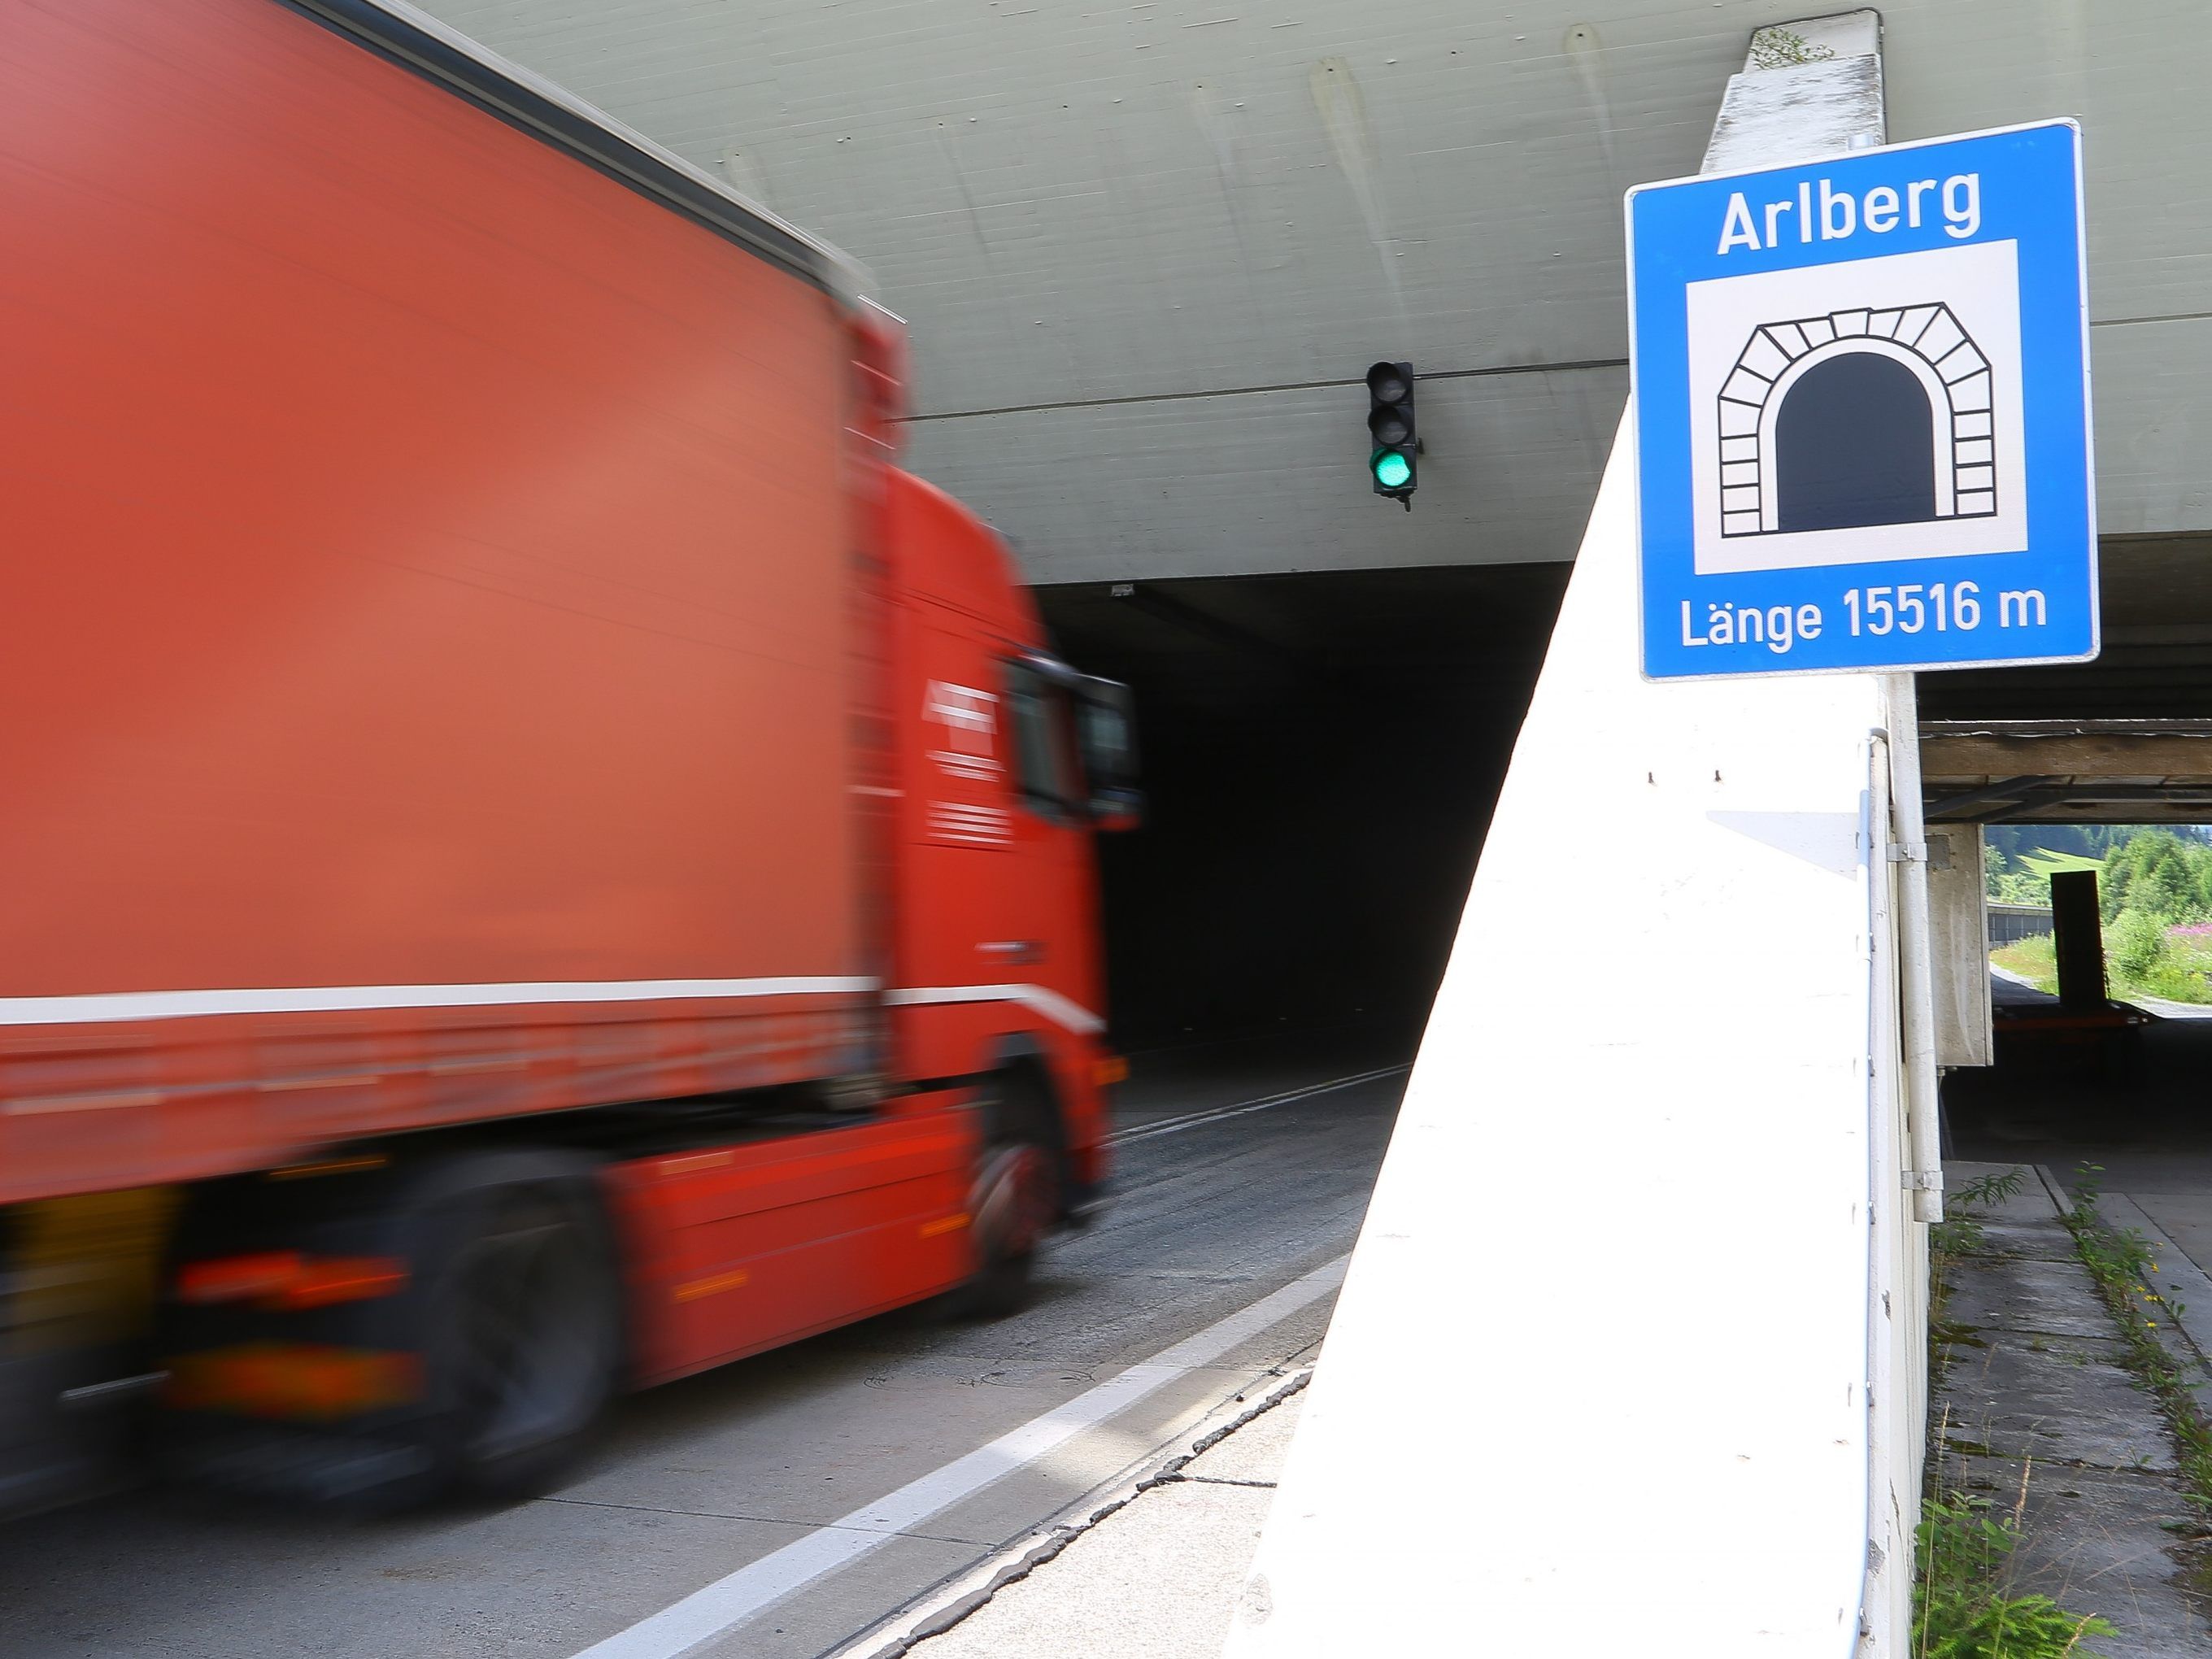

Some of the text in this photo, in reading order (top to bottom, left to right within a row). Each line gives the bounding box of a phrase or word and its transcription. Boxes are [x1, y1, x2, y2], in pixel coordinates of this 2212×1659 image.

[1717, 172, 1982, 255] Arlberg
[1681, 581, 2047, 654] Länge 15516 m
